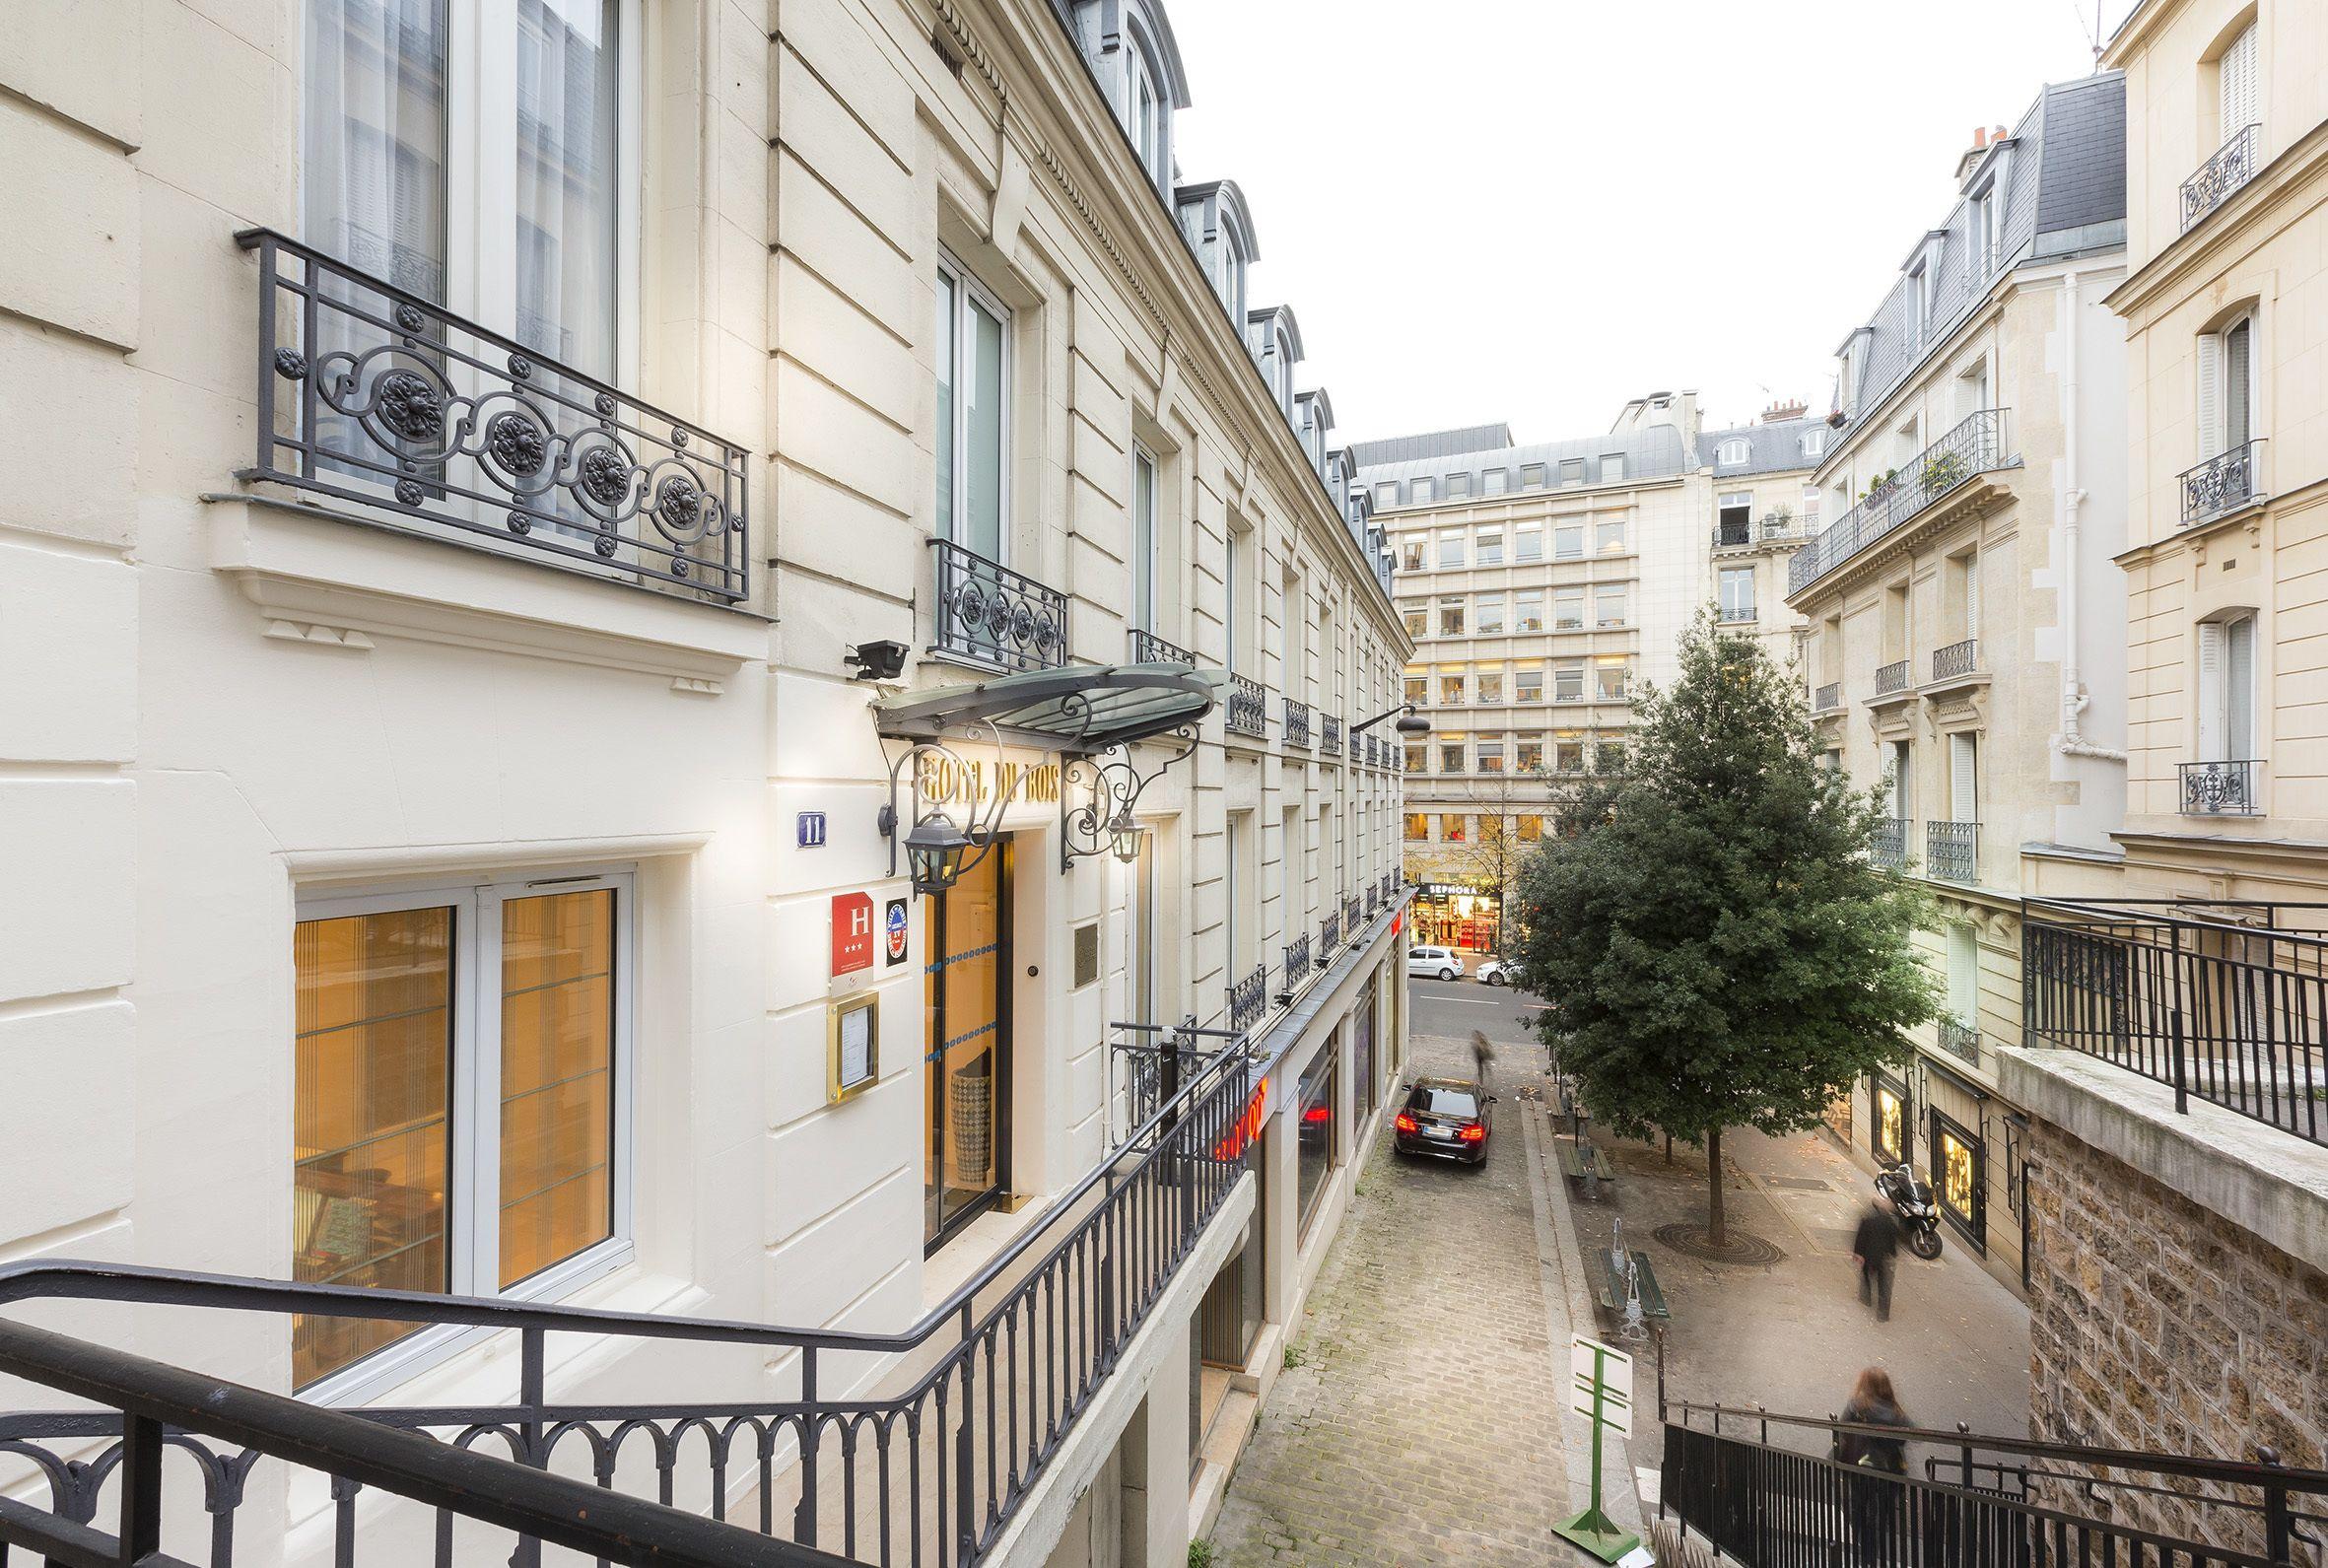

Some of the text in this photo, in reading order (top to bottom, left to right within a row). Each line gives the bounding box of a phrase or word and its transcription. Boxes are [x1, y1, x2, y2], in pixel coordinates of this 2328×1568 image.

[1025, 764, 1059, 803] BOIS
[805, 816, 820, 844] 11
[1429, 885, 1477, 895] SEPHORA
[851, 907, 869, 937] H
